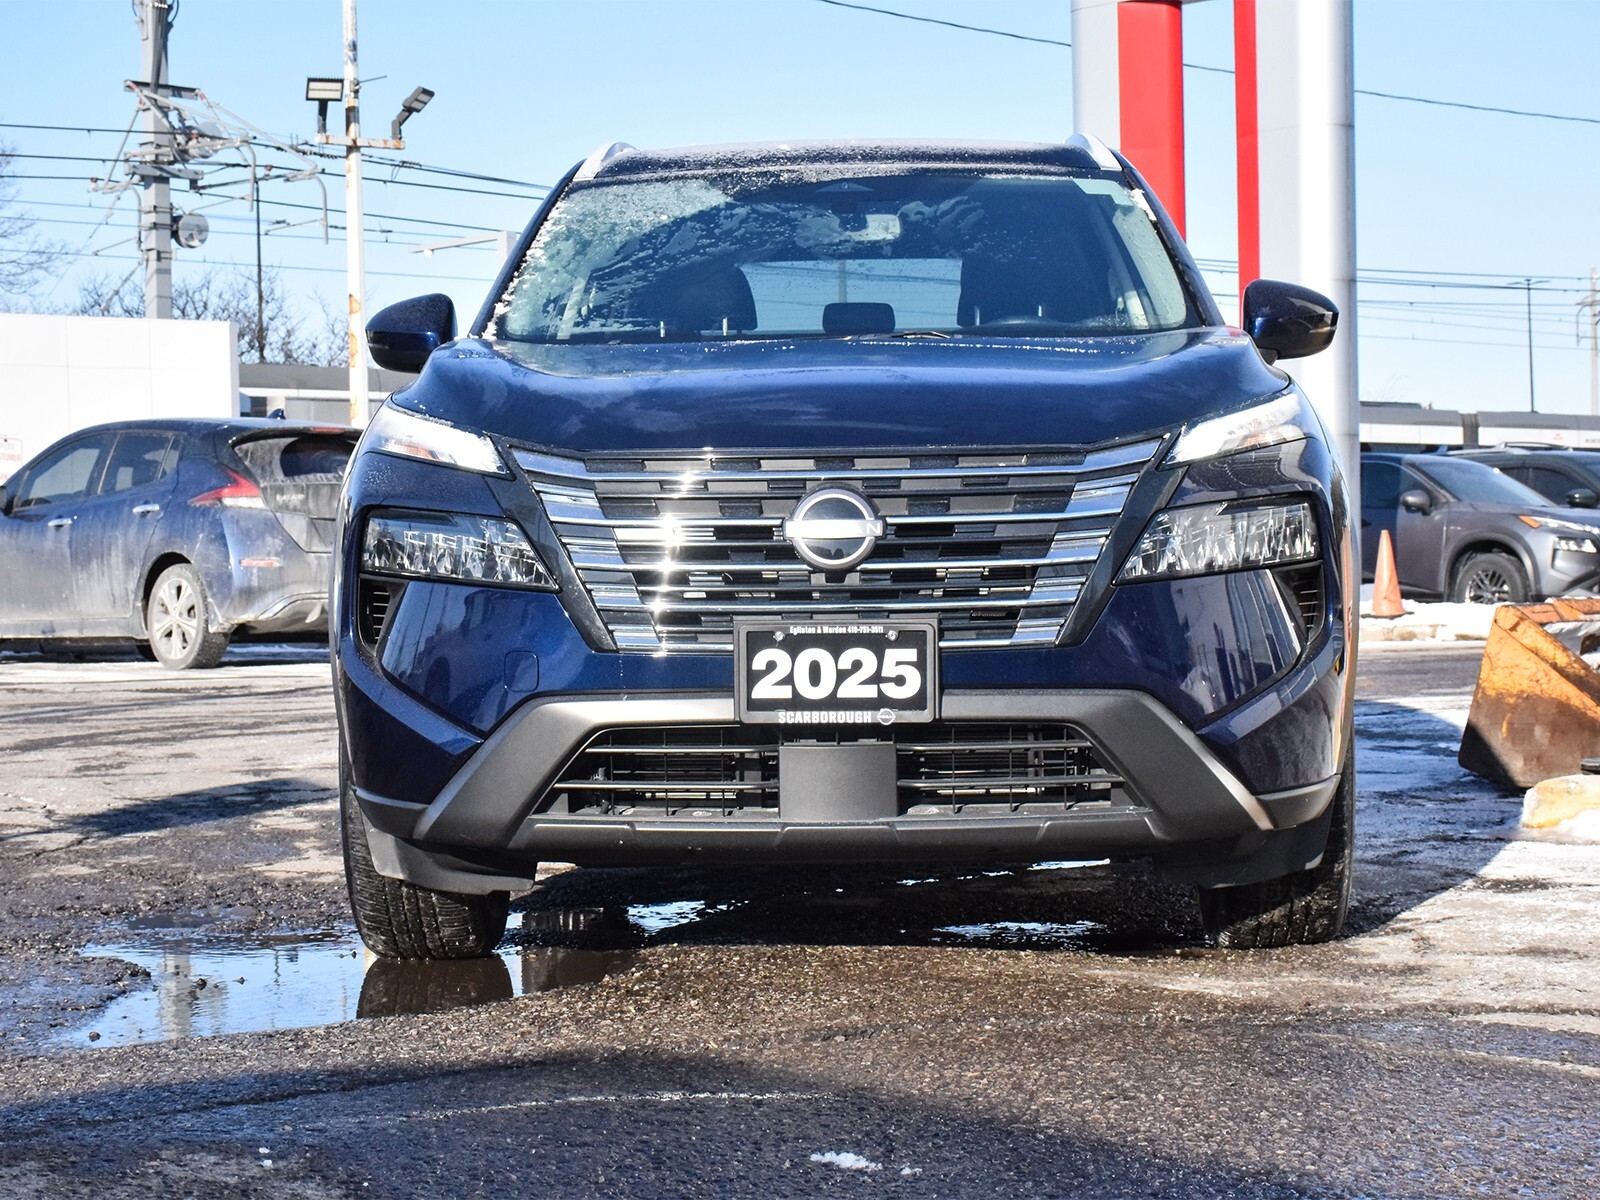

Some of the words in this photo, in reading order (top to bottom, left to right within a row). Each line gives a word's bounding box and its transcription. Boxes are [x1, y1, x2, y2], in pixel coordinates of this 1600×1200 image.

[817, 625, 822, 634] &
[751, 647, 922, 700] 2025
[778, 711, 872, 724] SCARBOROUGH
